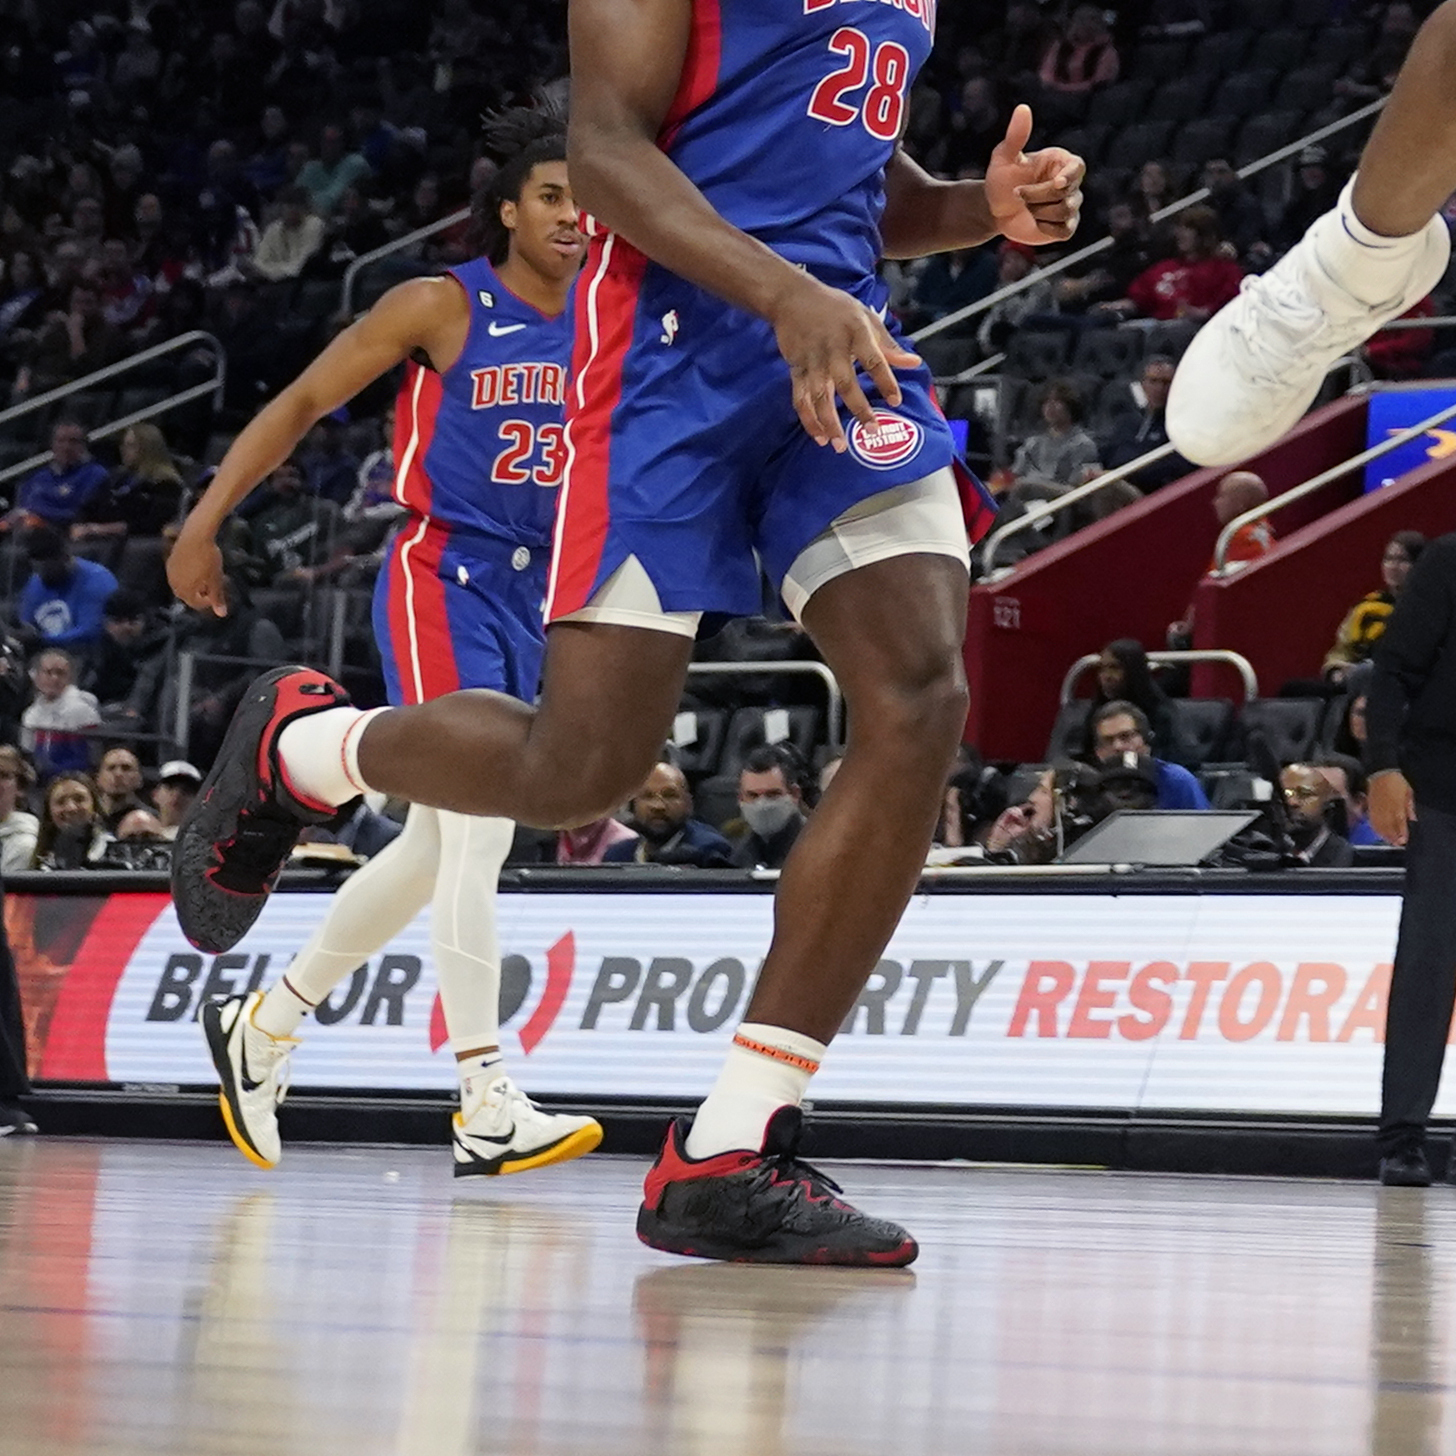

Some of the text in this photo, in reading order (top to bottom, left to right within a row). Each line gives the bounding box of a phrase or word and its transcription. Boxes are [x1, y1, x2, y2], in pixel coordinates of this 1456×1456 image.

[807, 26, 909, 141] 28
[491, 418, 567, 487] 23
[579, 956, 1005, 1038] PRORTY
